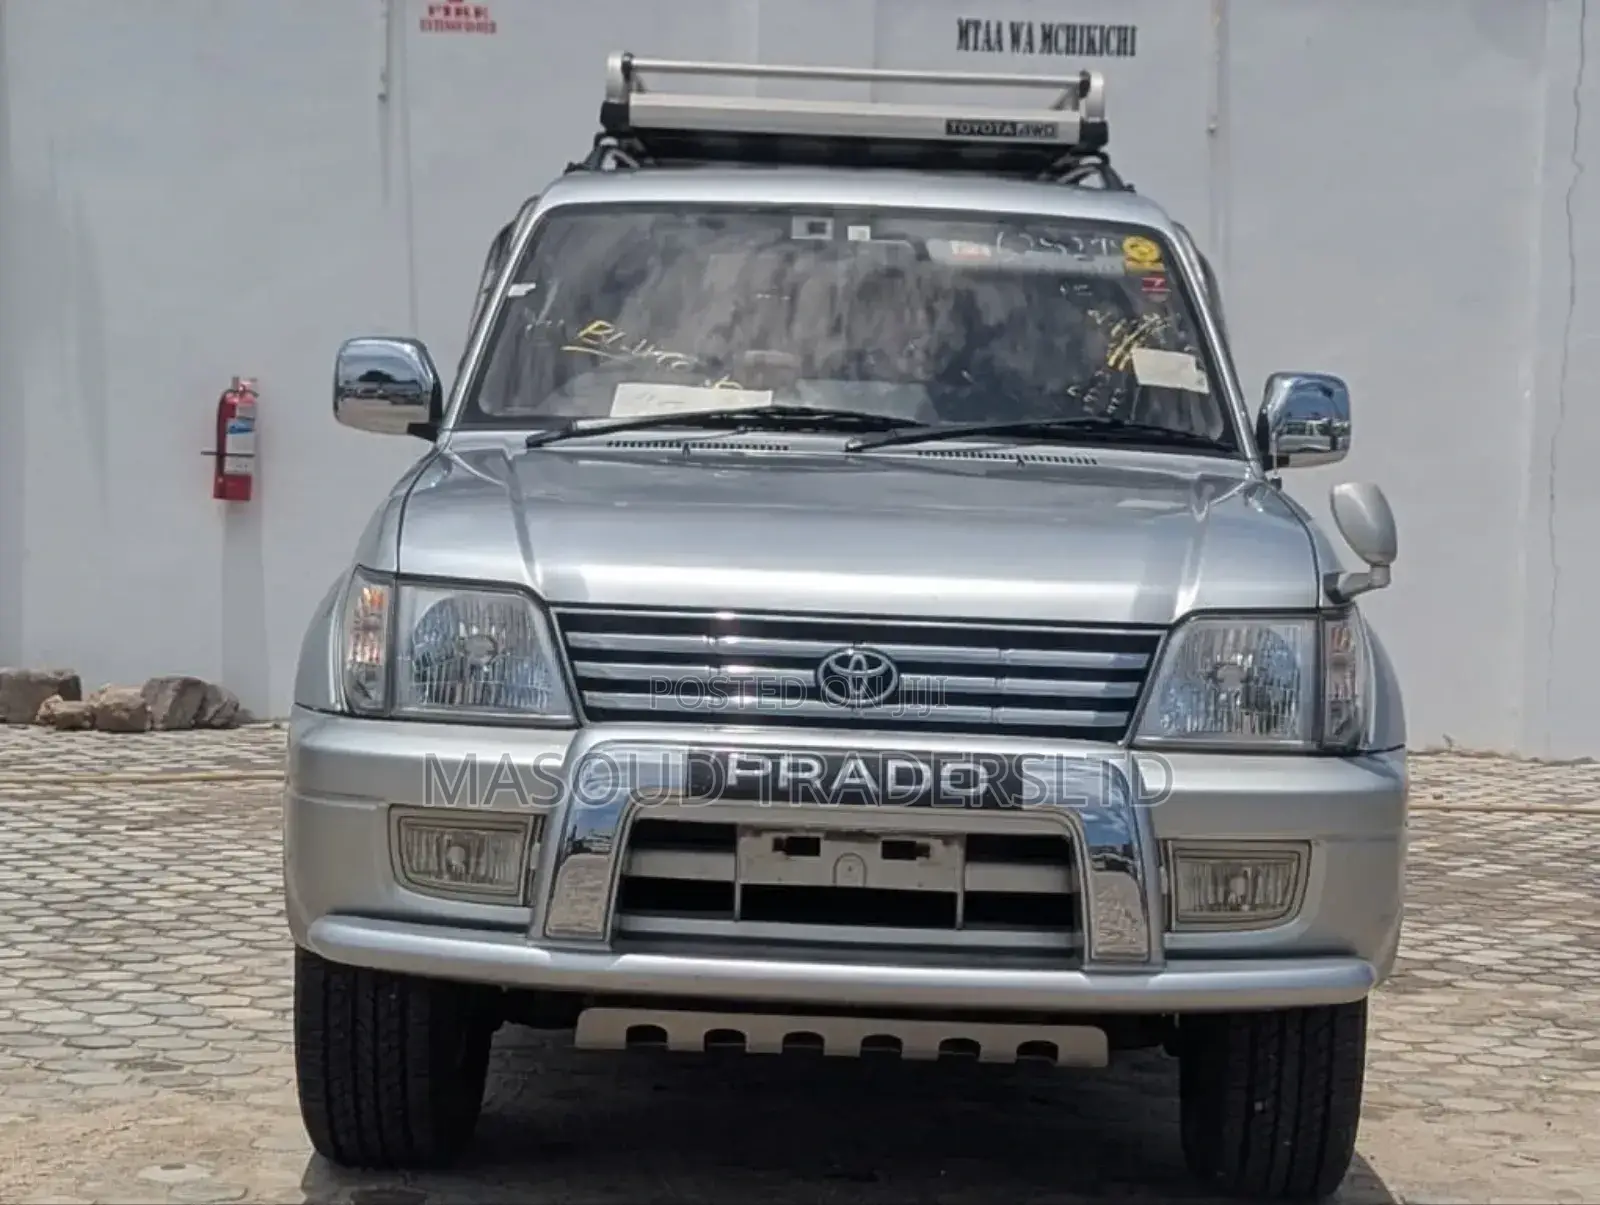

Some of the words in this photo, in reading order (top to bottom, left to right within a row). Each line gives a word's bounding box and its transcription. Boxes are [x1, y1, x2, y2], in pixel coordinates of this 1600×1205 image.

[957, 18, 1003, 52] MTAA
[1009, 21, 1034, 53] WA
[1040, 23, 1137, 57] MCHIKICHI
[948, 120, 1014, 136] TOYOTA
[727, 753, 989, 796] PRADO
